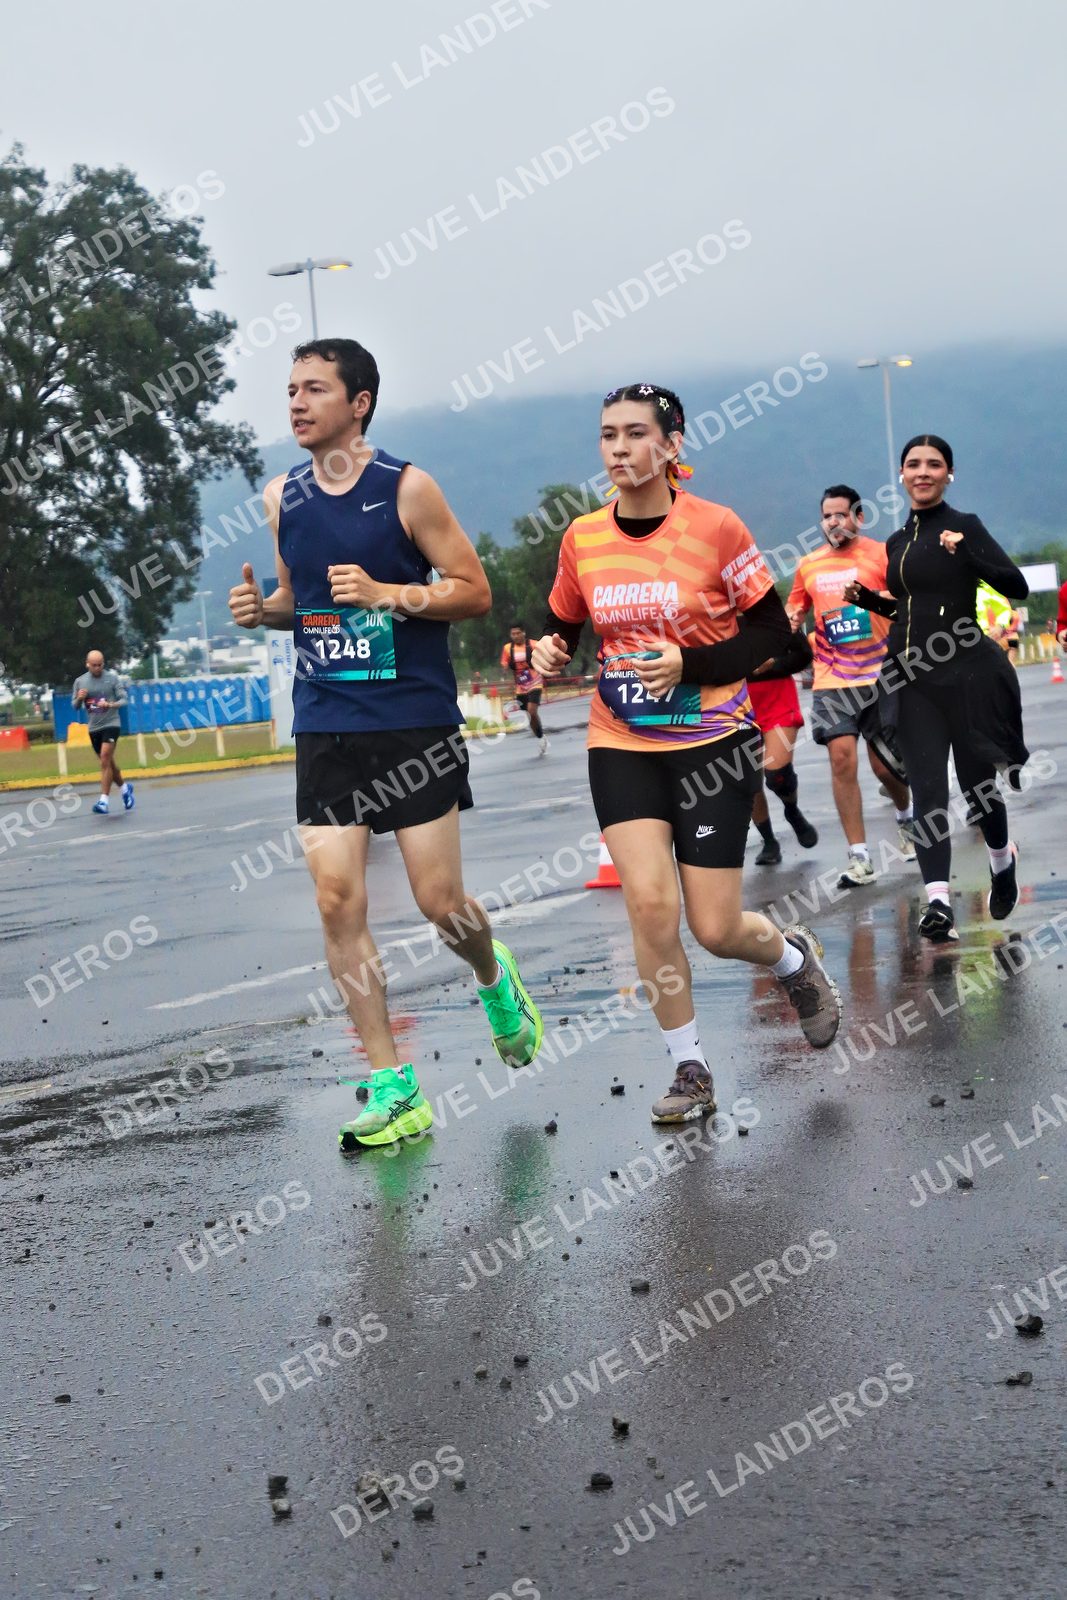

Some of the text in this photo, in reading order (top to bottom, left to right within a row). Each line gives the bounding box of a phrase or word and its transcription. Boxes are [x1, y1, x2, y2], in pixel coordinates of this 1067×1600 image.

[593, 581, 679, 608] CARRERA
[303, 613, 384, 627] CARRERA 10K
[594, 607, 658, 624] OMNILIFE
[830, 619, 860, 635] 1432
[315, 638, 371, 660] 1248
[605, 670, 635, 679] OMNILIFE
[698, 824, 714, 834] NIKE
